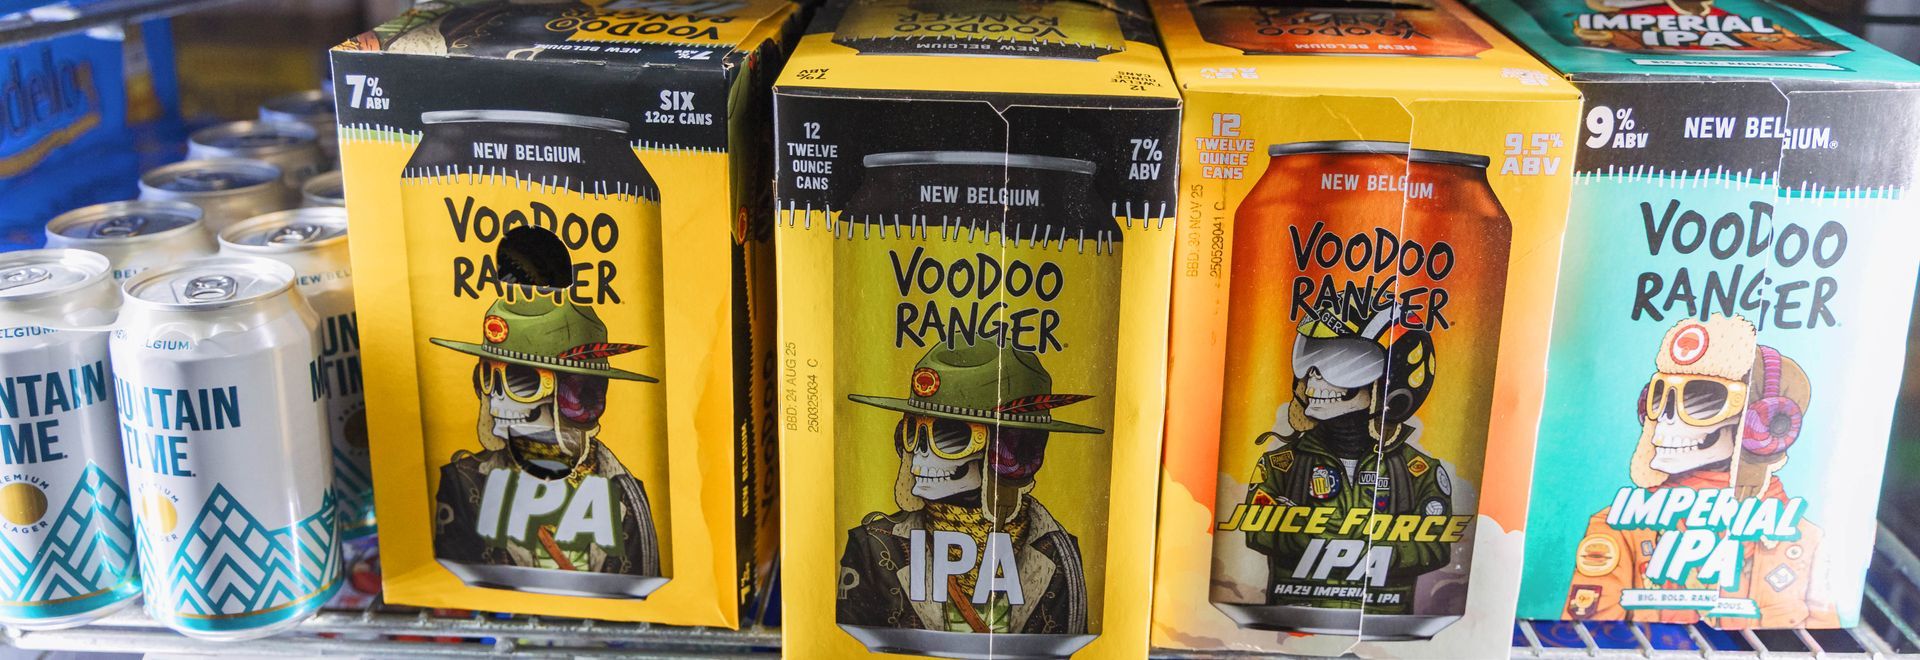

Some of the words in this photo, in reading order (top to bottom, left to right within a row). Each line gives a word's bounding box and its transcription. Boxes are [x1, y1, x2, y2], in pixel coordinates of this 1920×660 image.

[544, 16, 719, 40] VOODOO
[893, 23, 1068, 39] VOODOO
[1579, 14, 1776, 34] IMPERIAL
[1000, 44, 1040, 52] NEW
[1377, 43, 1418, 51] NEW
[1642, 31, 1745, 48] IPA
[346, 75, 383, 108] 7%
[659, 89, 695, 111] SIX
[366, 97, 390, 110] ABV
[645, 111, 675, 124] 12oz
[679, 112, 712, 126] CANS
[1211, 112, 1242, 137] 12
[1585, 105, 1636, 150] 9%
[1684, 117, 1737, 140] NEW
[803, 122, 821, 140] 12
[1612, 132, 1649, 150] ABV
[473, 142, 508, 160] NEW
[516, 144, 581, 163] BELGIUM
[787, 142, 838, 158] TWELVE
[1130, 138, 1163, 161] 7%
[1195, 137, 1255, 152] TWELVE
[1504, 132, 1565, 156] 9.5%
[792, 160, 833, 175] OUNCE
[1199, 151, 1249, 166] OUNCE
[1500, 156, 1561, 176] ABV
[1128, 163, 1161, 180] ABV
[1202, 166, 1244, 180] CANS
[796, 176, 829, 190] CANS
[1191, 184, 1204, 199] 25
[1321, 173, 1360, 191] NEW
[1367, 174, 1434, 199] BELGUM
[920, 185, 959, 204] NEW
[967, 187, 1039, 207] BELGIUM
[1640, 198, 1849, 270] VOODOO
[1288, 220, 1456, 282] VOODOO
[295, 273, 322, 288] EW
[453, 253, 621, 306] RAER
[889, 246, 1064, 302] VOODOO
[1290, 273, 1450, 332] RANGER
[1631, 263, 1839, 332] RANGER
[895, 300, 1063, 354] RANGER
[785, 341, 796, 356] 25
[786, 359, 797, 387] AUG
[786, 387, 797, 402] 24
[0, 473, 50, 490] EMIUM
[1361, 473, 1389, 489] VOOOO
[477, 467, 616, 548] IPA
[1606, 486, 1804, 538] IMPERIAL
[3, 521, 49, 534] LAGER
[1217, 503, 1337, 534] JUICE
[1338, 507, 1474, 544] FORCE
[910, 529, 1025, 605] IPA
[1291, 538, 1394, 588] IPA
[1645, 529, 1743, 589] IPA
[1274, 584, 1309, 596] HAZY
[1377, 593, 1401, 605] IPA
[1691, 593, 1745, 611] RANGROUS.
